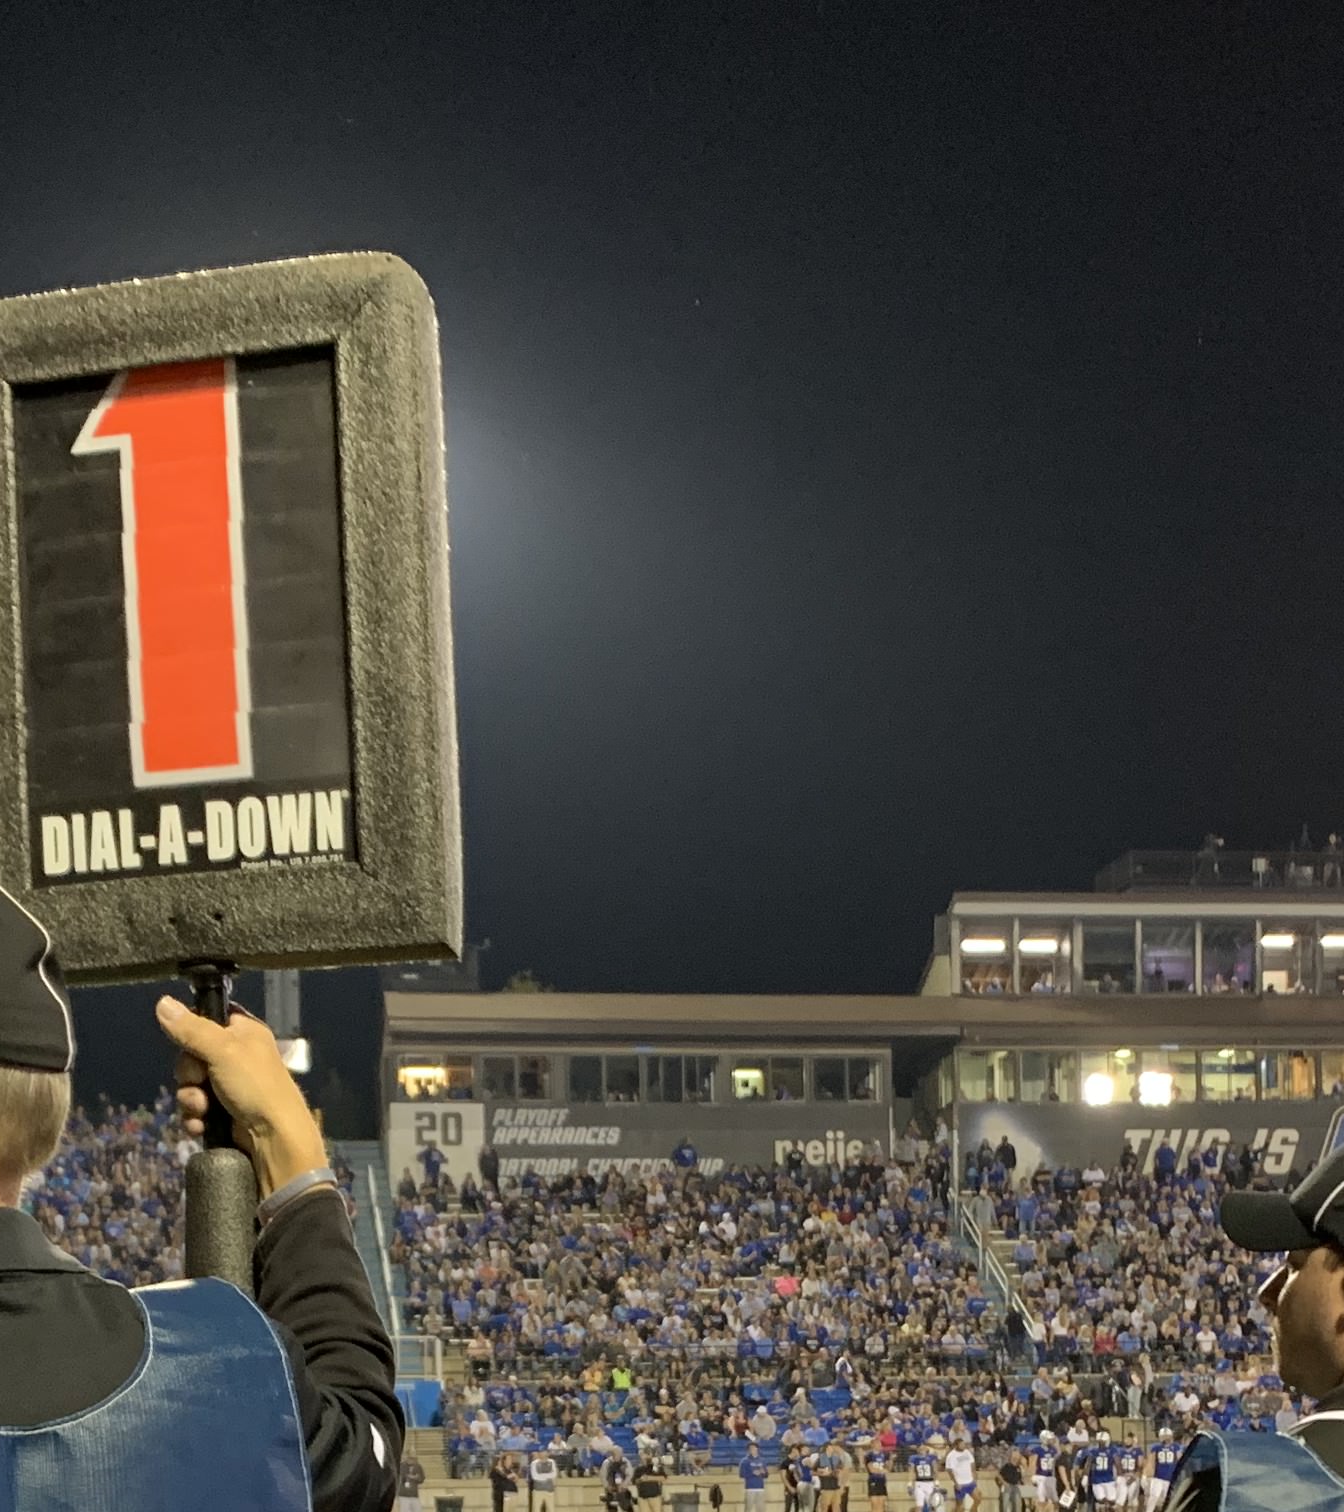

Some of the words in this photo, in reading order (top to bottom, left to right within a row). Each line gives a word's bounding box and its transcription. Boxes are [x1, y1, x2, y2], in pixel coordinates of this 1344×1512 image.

[72, 352, 253, 789] 1
[41, 791, 346, 877] DIAL-A-DOWN
[414, 1110, 463, 1146] 20
[492, 1108, 570, 1126] PLAYOFF
[492, 1126, 621, 1145] APPEARANCES
[587, 1158, 725, 1177] CHAMPIOHIP
[773, 1129, 866, 1173] meije
[1123, 1128, 1232, 1174] THIS
